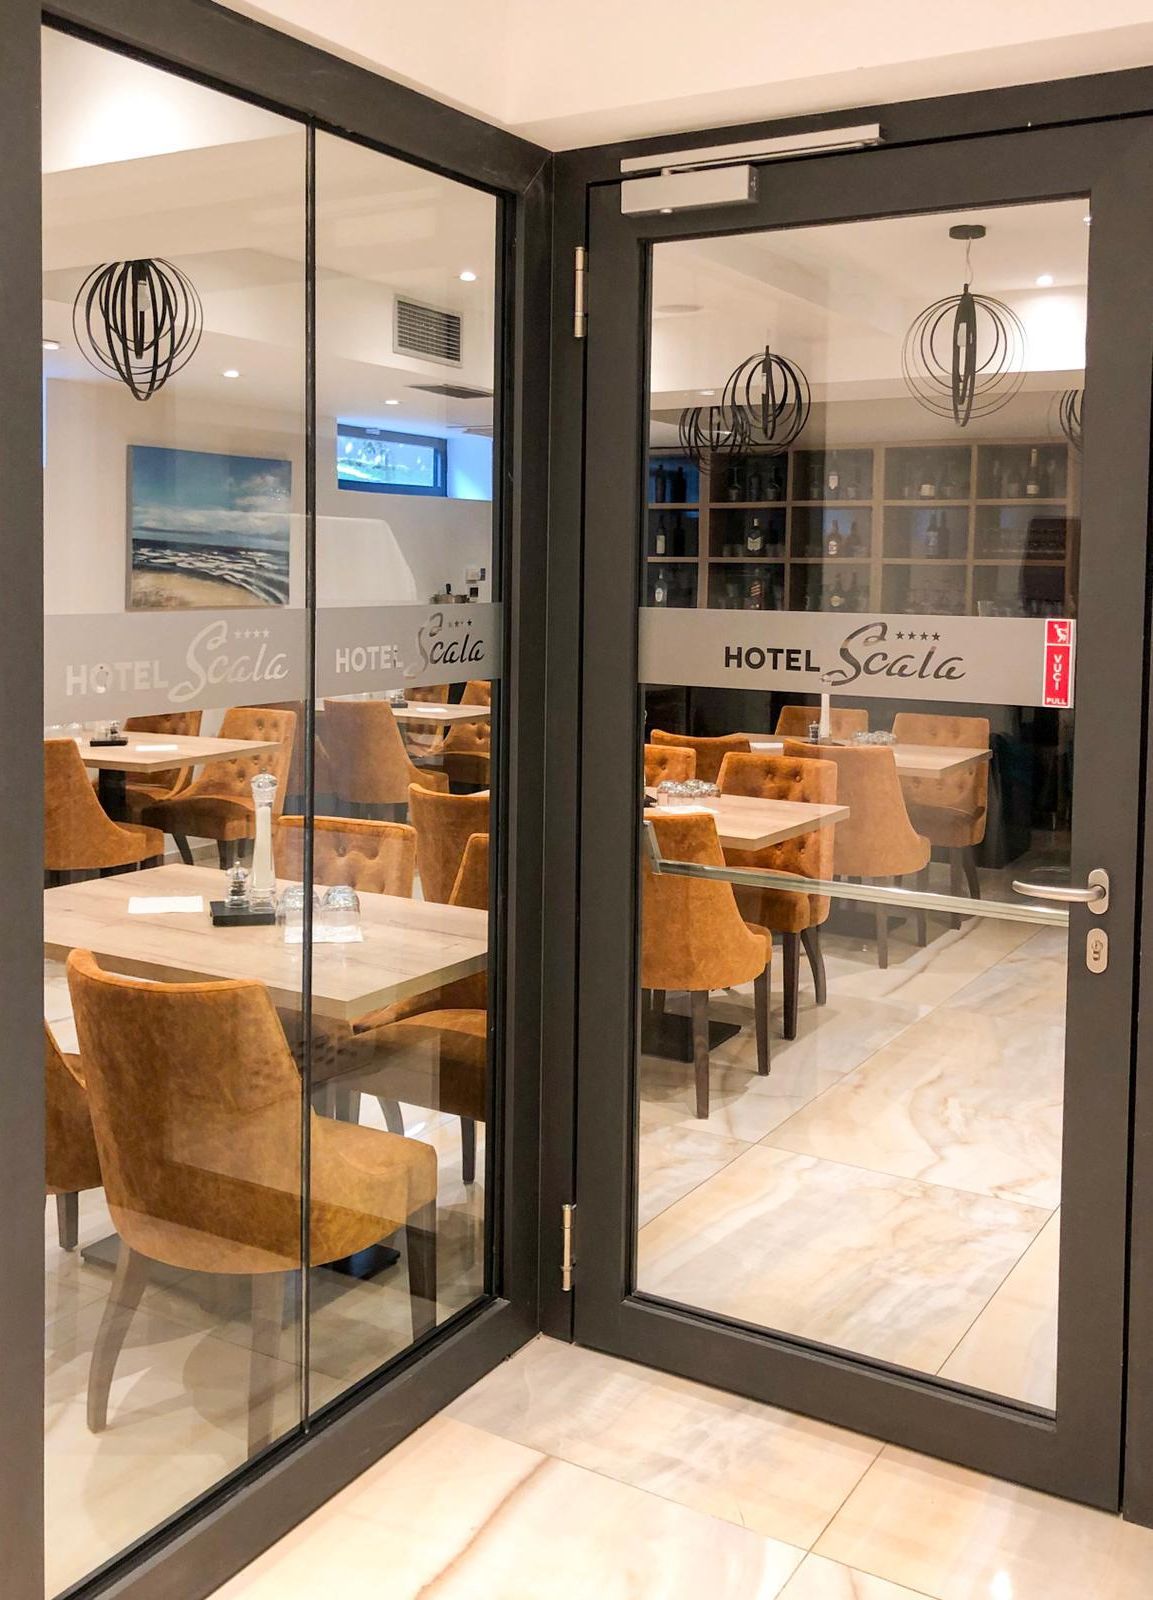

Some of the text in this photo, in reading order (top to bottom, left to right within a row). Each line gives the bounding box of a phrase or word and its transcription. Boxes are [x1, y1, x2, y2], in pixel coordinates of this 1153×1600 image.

[65, 620, 290, 703] HOTEL Scala
[335, 612, 485, 680] HOTEL Scala
[724, 622, 967, 686] HOTEL Scala
[1052, 654, 1063, 691] VUCI
[1046, 697, 1067, 705] PULL
